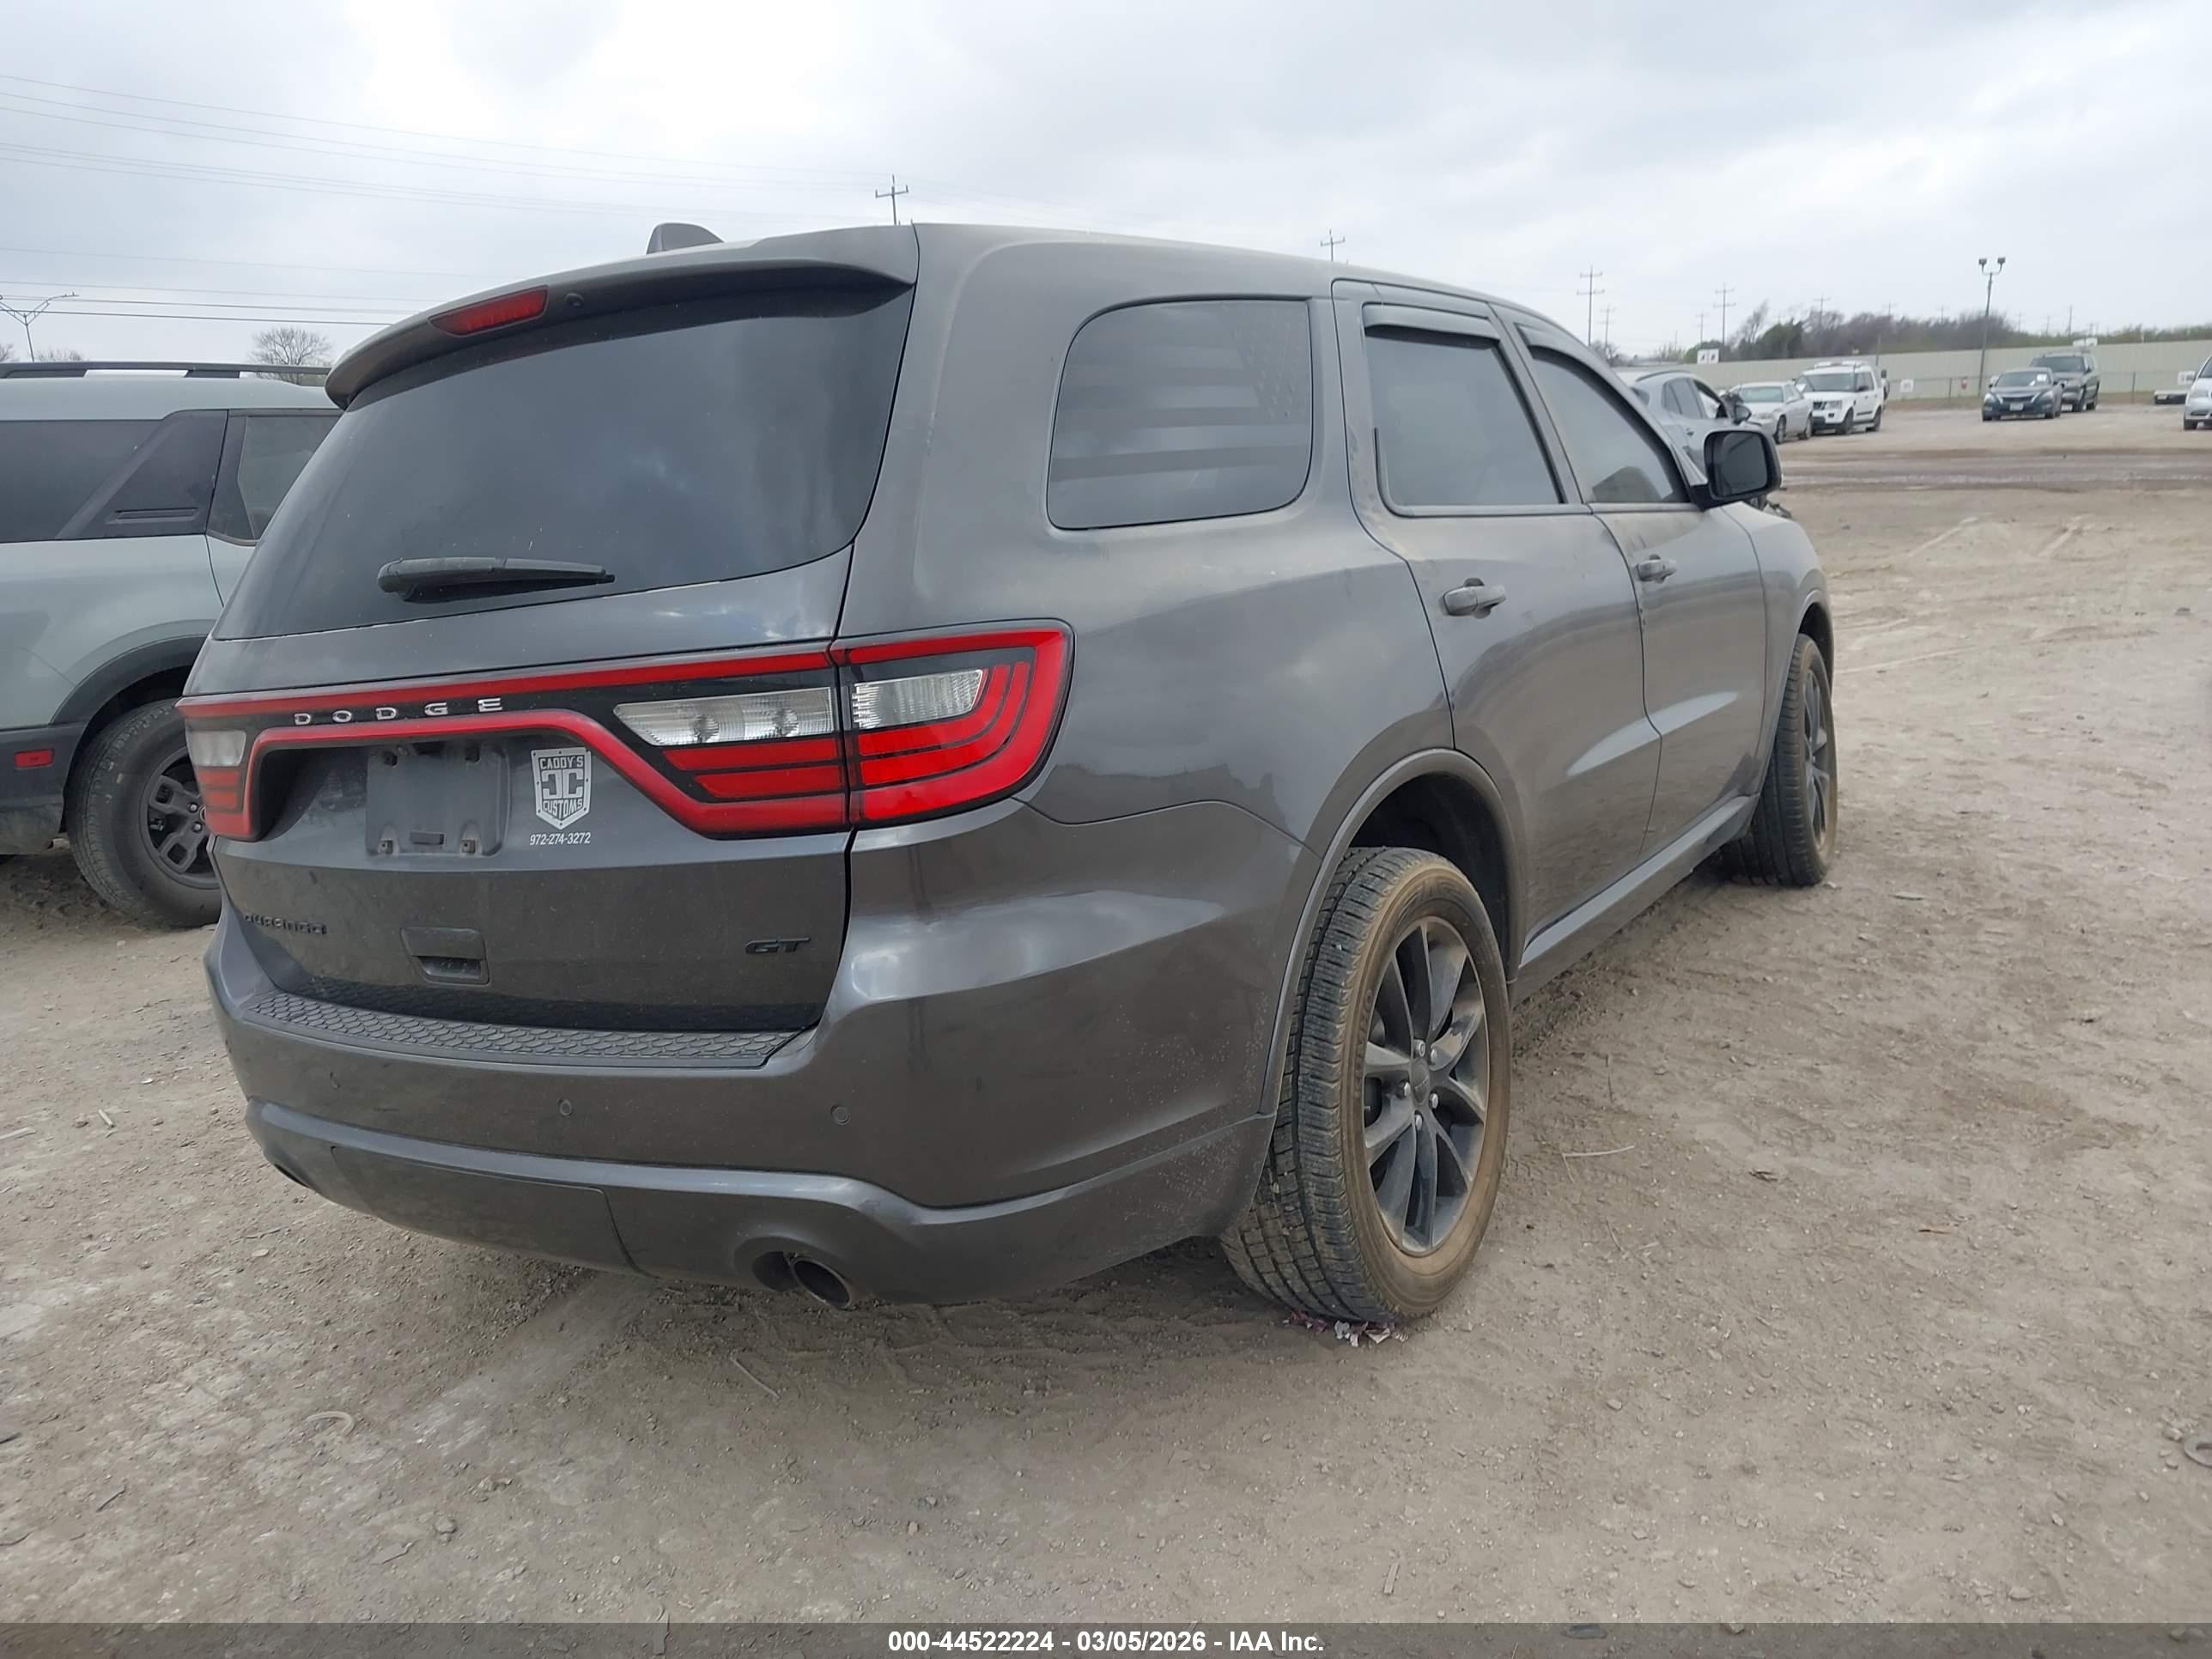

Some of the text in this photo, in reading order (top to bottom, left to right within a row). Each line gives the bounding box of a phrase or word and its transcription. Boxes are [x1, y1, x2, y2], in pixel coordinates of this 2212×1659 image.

[294, 696, 502, 726] DODGE
[538, 756, 584, 770] CADDY'S
[543, 799, 583, 819] CUSTOMS
[529, 832, 592, 846] 972-274-3272
[745, 938, 811, 954] GT
